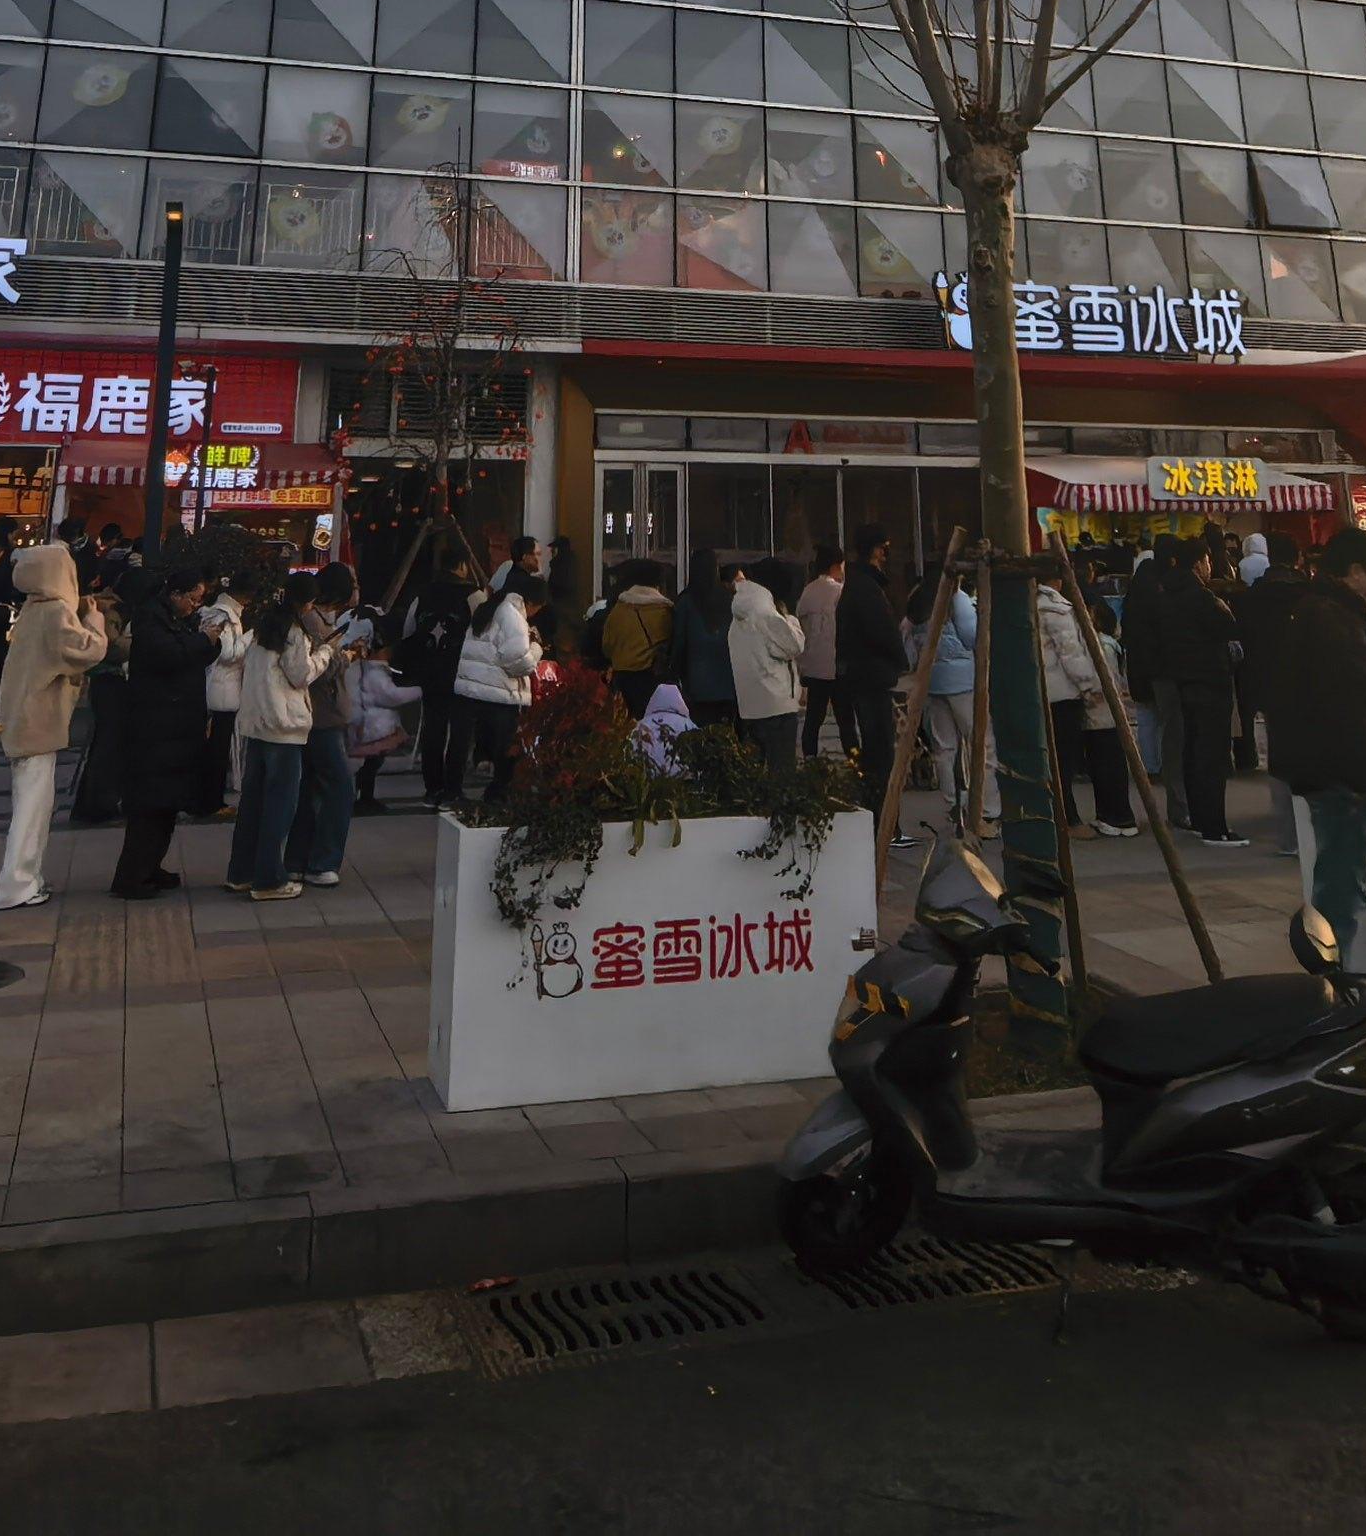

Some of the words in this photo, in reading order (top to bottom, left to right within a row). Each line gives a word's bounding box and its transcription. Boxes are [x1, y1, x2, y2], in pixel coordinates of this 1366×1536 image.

[1012, 279, 1248, 356] 蜜雪冰城
[13, 372, 218, 435] 福鹿家
[206, 445, 252, 467] 鲜啤
[1161, 458, 1259, 498] 冰淇淋
[590, 907, 815, 990] 蜜雪冰城
